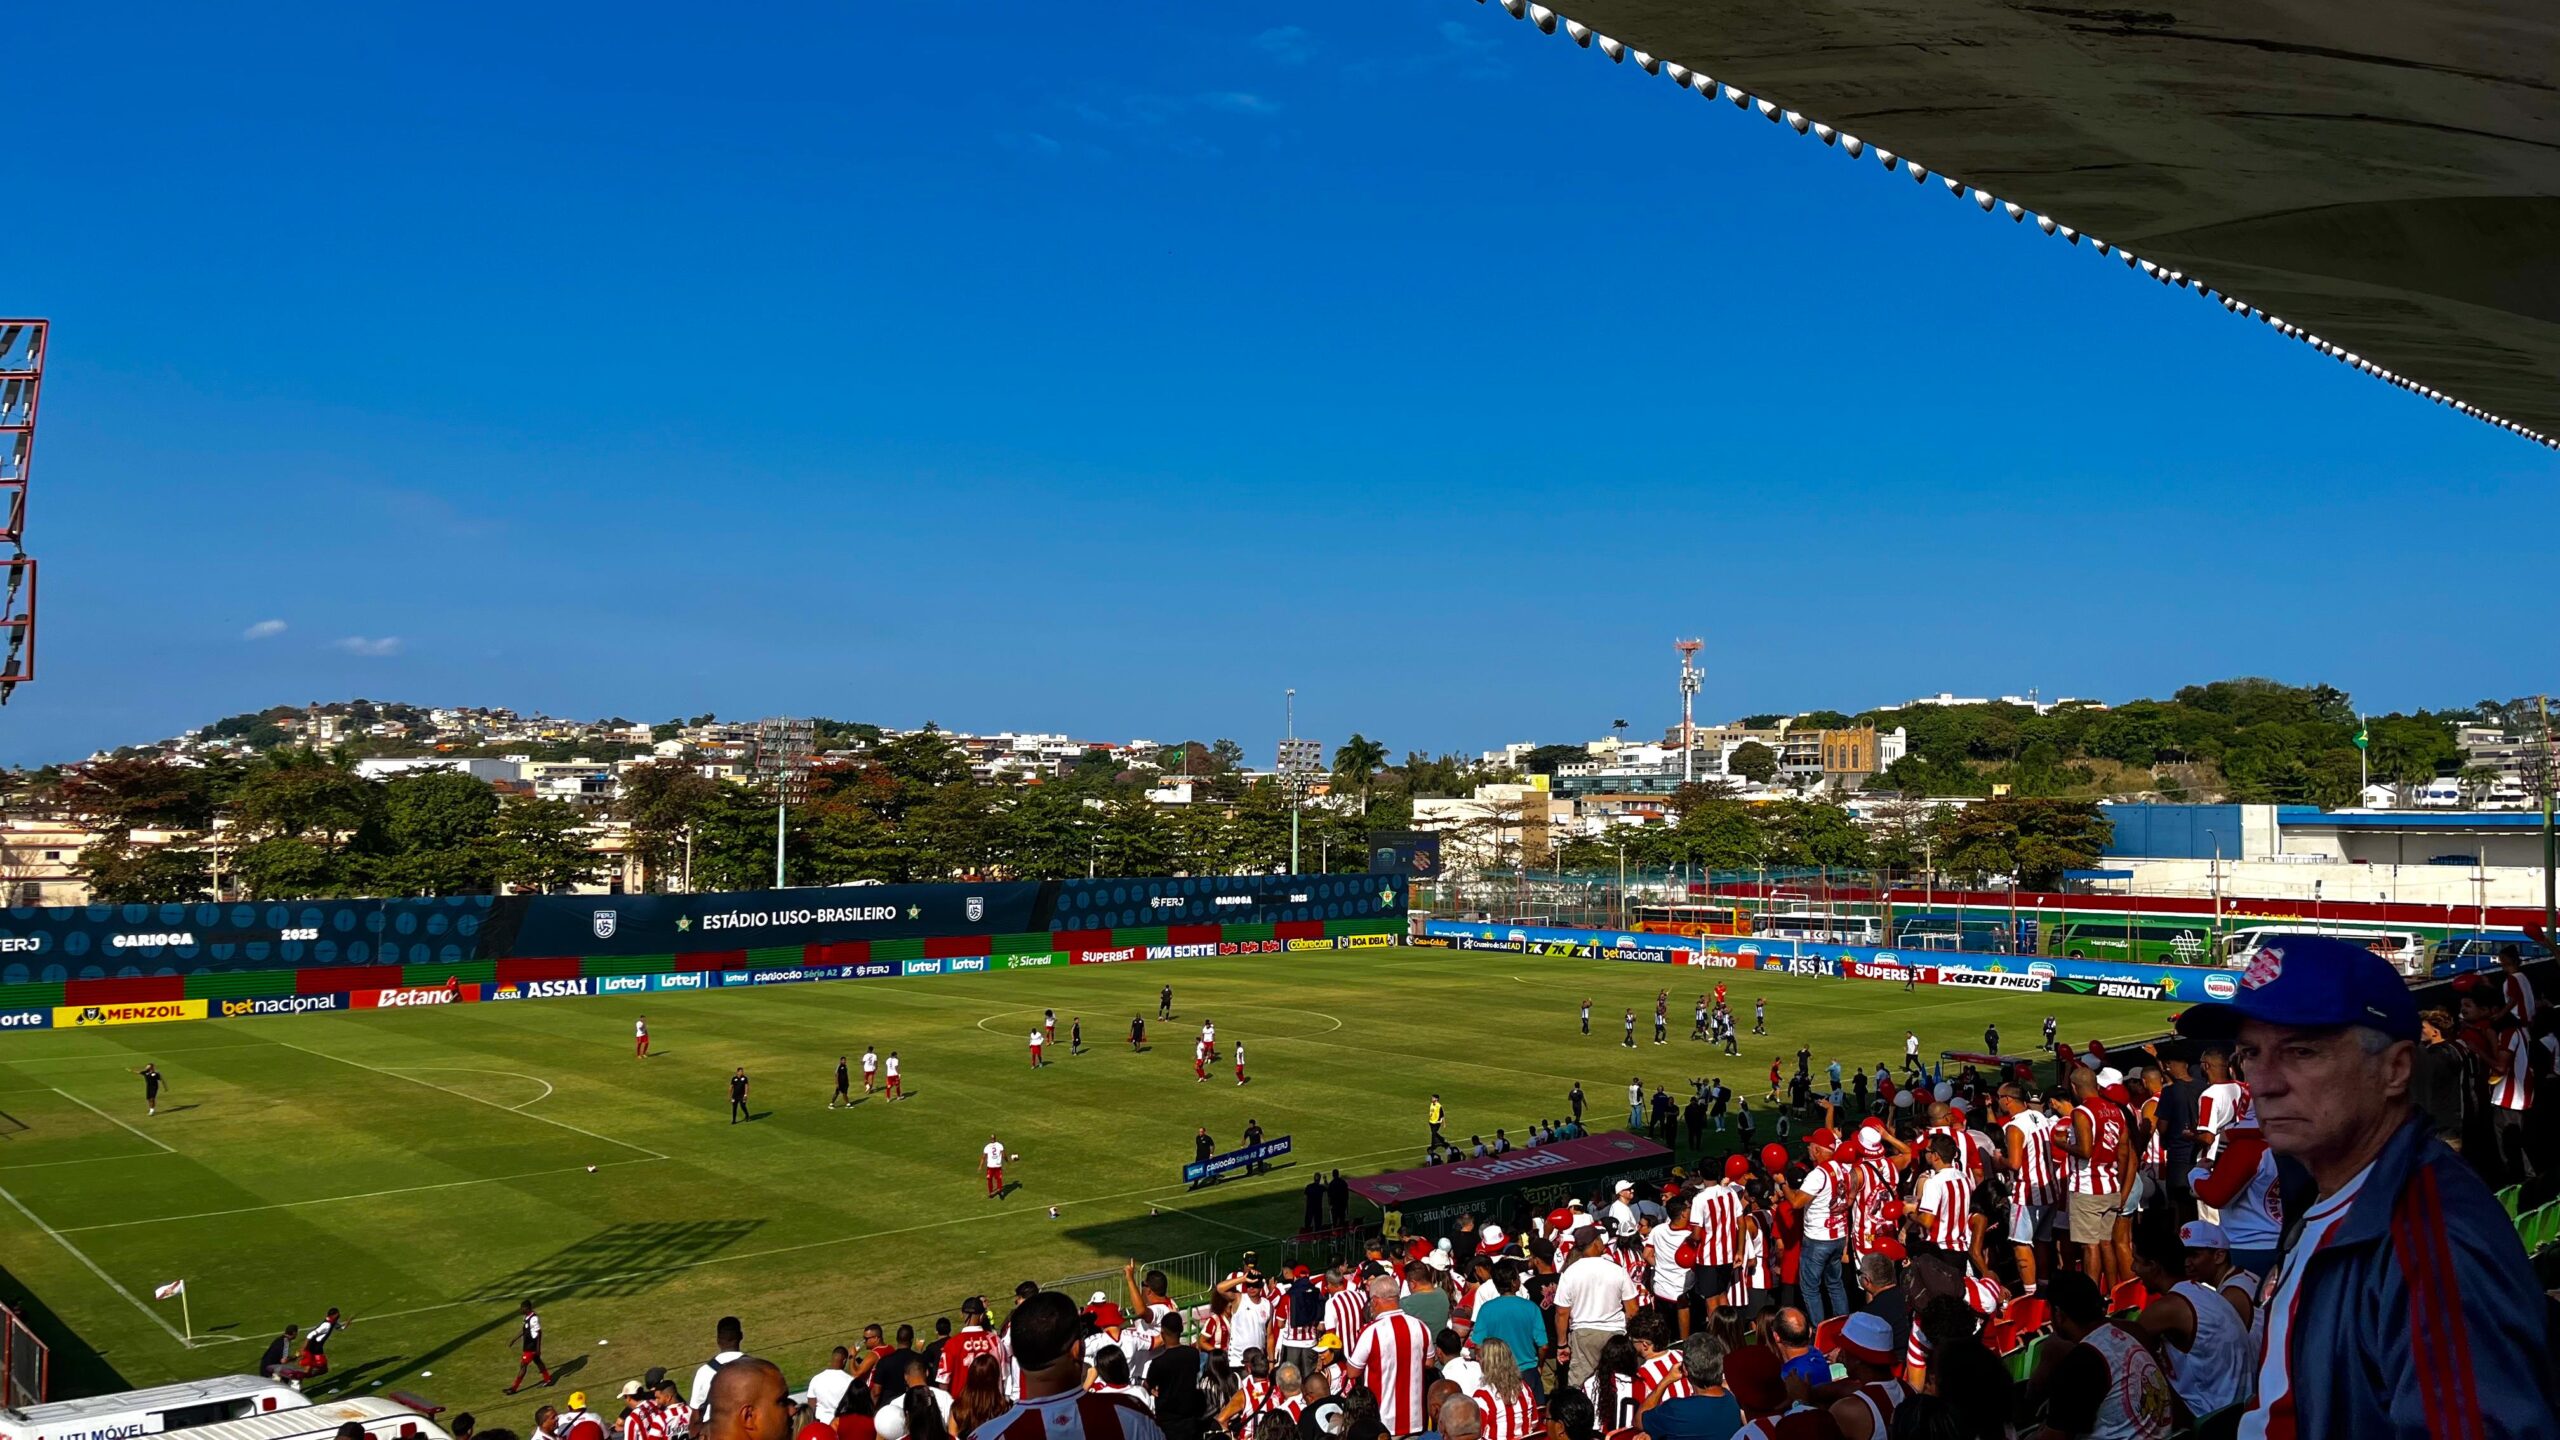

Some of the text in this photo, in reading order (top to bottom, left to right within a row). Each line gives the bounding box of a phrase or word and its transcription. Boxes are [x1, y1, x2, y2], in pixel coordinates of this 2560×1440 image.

[1161, 897, 1184, 907] FERJ
[1215, 896, 1252, 905] CARIOCA
[703, 906, 896, 930] ESTÁDIO LUSO-BRASILEIRO
[113, 932, 195, 948] CARIOCA
[281, 928, 319, 941] 2025
[1352, 938, 1367, 946] BOA
[0, 938, 41, 952] ERJ
[1146, 943, 1215, 959] VIVA SORTE
[1290, 938, 1333, 949] cobrecom
[1507, 942, 1521, 950] EAD
[1528, 944, 1543, 954] 7K
[1081, 948, 1135, 963] SUPERBET
[1576, 947, 1592, 957] 7K
[1602, 947, 1665, 962] betnacional
[908, 959, 941, 974] Loterj
[952, 957, 984, 971] Loterj
[1020, 954, 1052, 967] Sicredi
[826, 968, 838, 977] A2
[866, 966, 890, 975] FERJ
[605, 975, 647, 991] Loterj
[661, 972, 701, 988] Loterj
[1941, 972, 2041, 989] XBRI PNEUS
[378, 988, 453, 1008] Betano
[2098, 983, 2162, 1000] PENALTY
[222, 994, 336, 1016] betnacional
[108, 1006, 185, 1021] MENZOIL
[91, 1424, 148, 1440] MÓVEL
